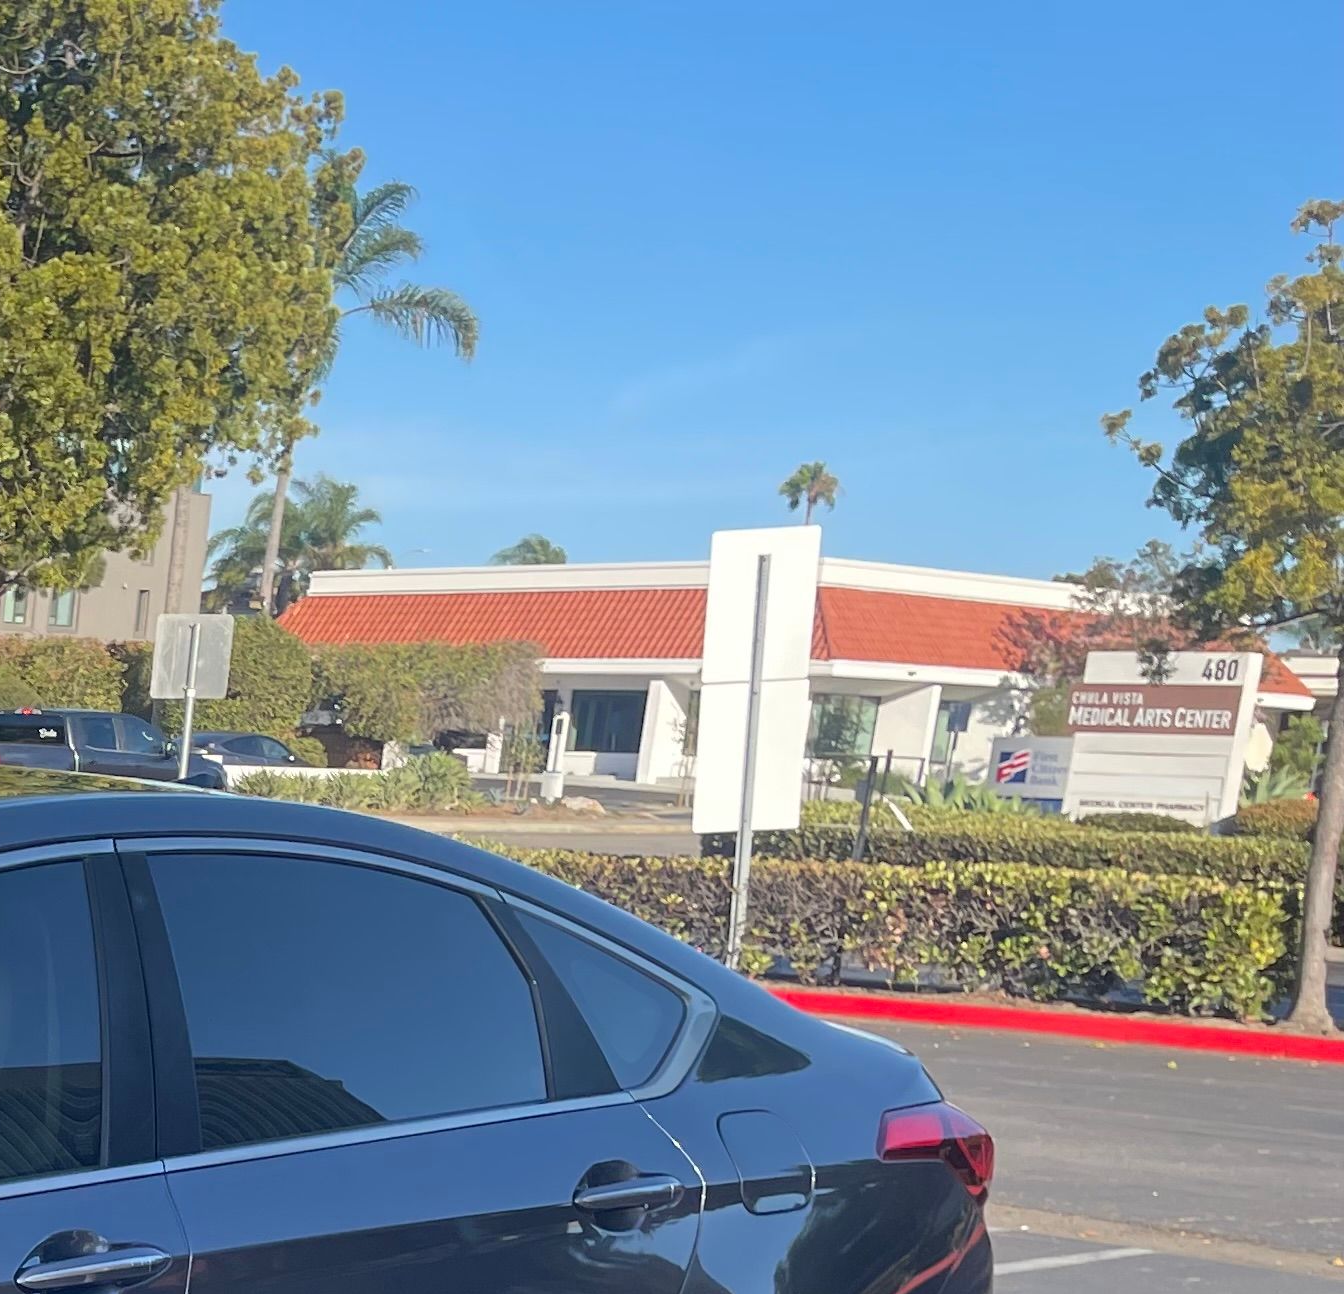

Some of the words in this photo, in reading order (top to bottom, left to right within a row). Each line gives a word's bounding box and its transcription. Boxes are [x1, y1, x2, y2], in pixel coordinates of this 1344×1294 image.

[1202, 658, 1238, 681] 480
[1072, 691, 1108, 705] CHULA
[1112, 691, 1144, 706] VISTA
[1068, 705, 1131, 727] MEDICAL
[1133, 706, 1172, 728] ARTS
[1174, 707, 1232, 729] CENTER
